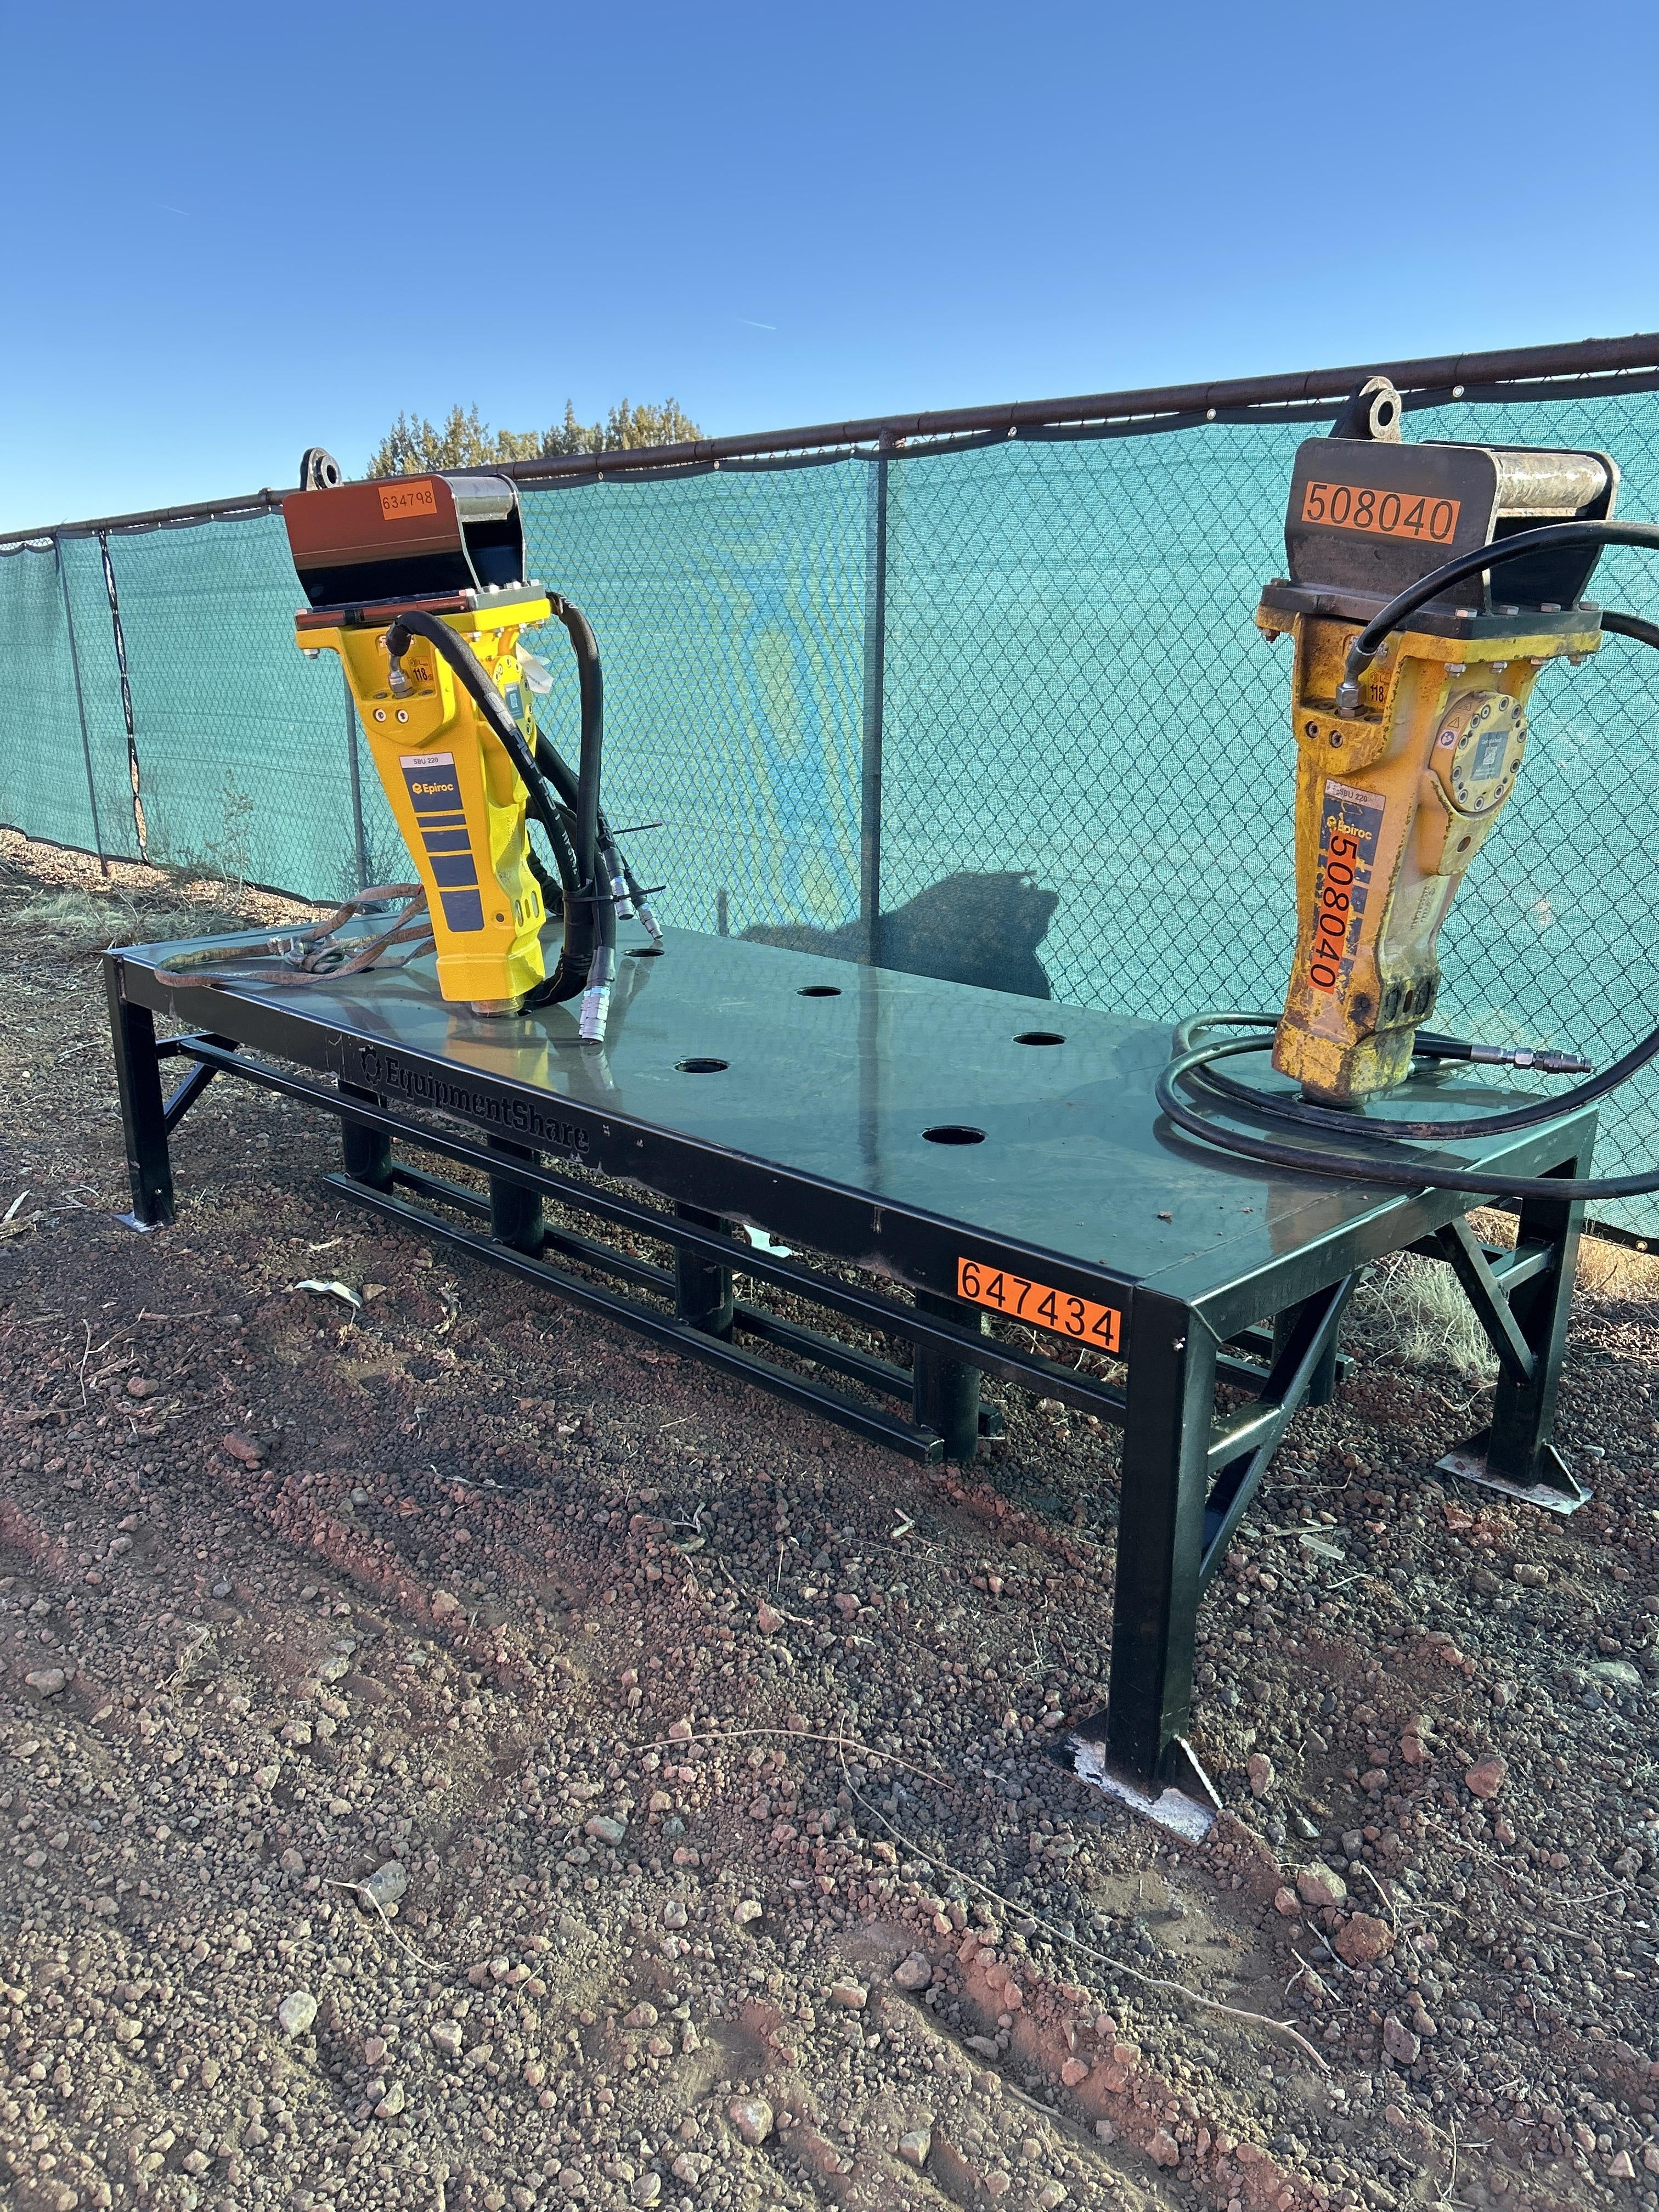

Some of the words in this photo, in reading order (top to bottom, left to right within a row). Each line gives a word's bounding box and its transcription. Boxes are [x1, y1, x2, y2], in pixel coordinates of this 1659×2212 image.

[383, 491, 432, 509] 634798
[1307, 484, 1453, 540] 508040
[413, 667, 427, 681] 118
[1370, 684, 1384, 702] 118
[422, 782, 454, 795] Epiroc
[1339, 789, 1353, 798] SBU
[1355, 793, 1368, 802] 220
[1310, 835, 1357, 988] 508040
[385, 1056, 590, 1154] EquipmentShare
[962, 1262, 1114, 1346] 647434
